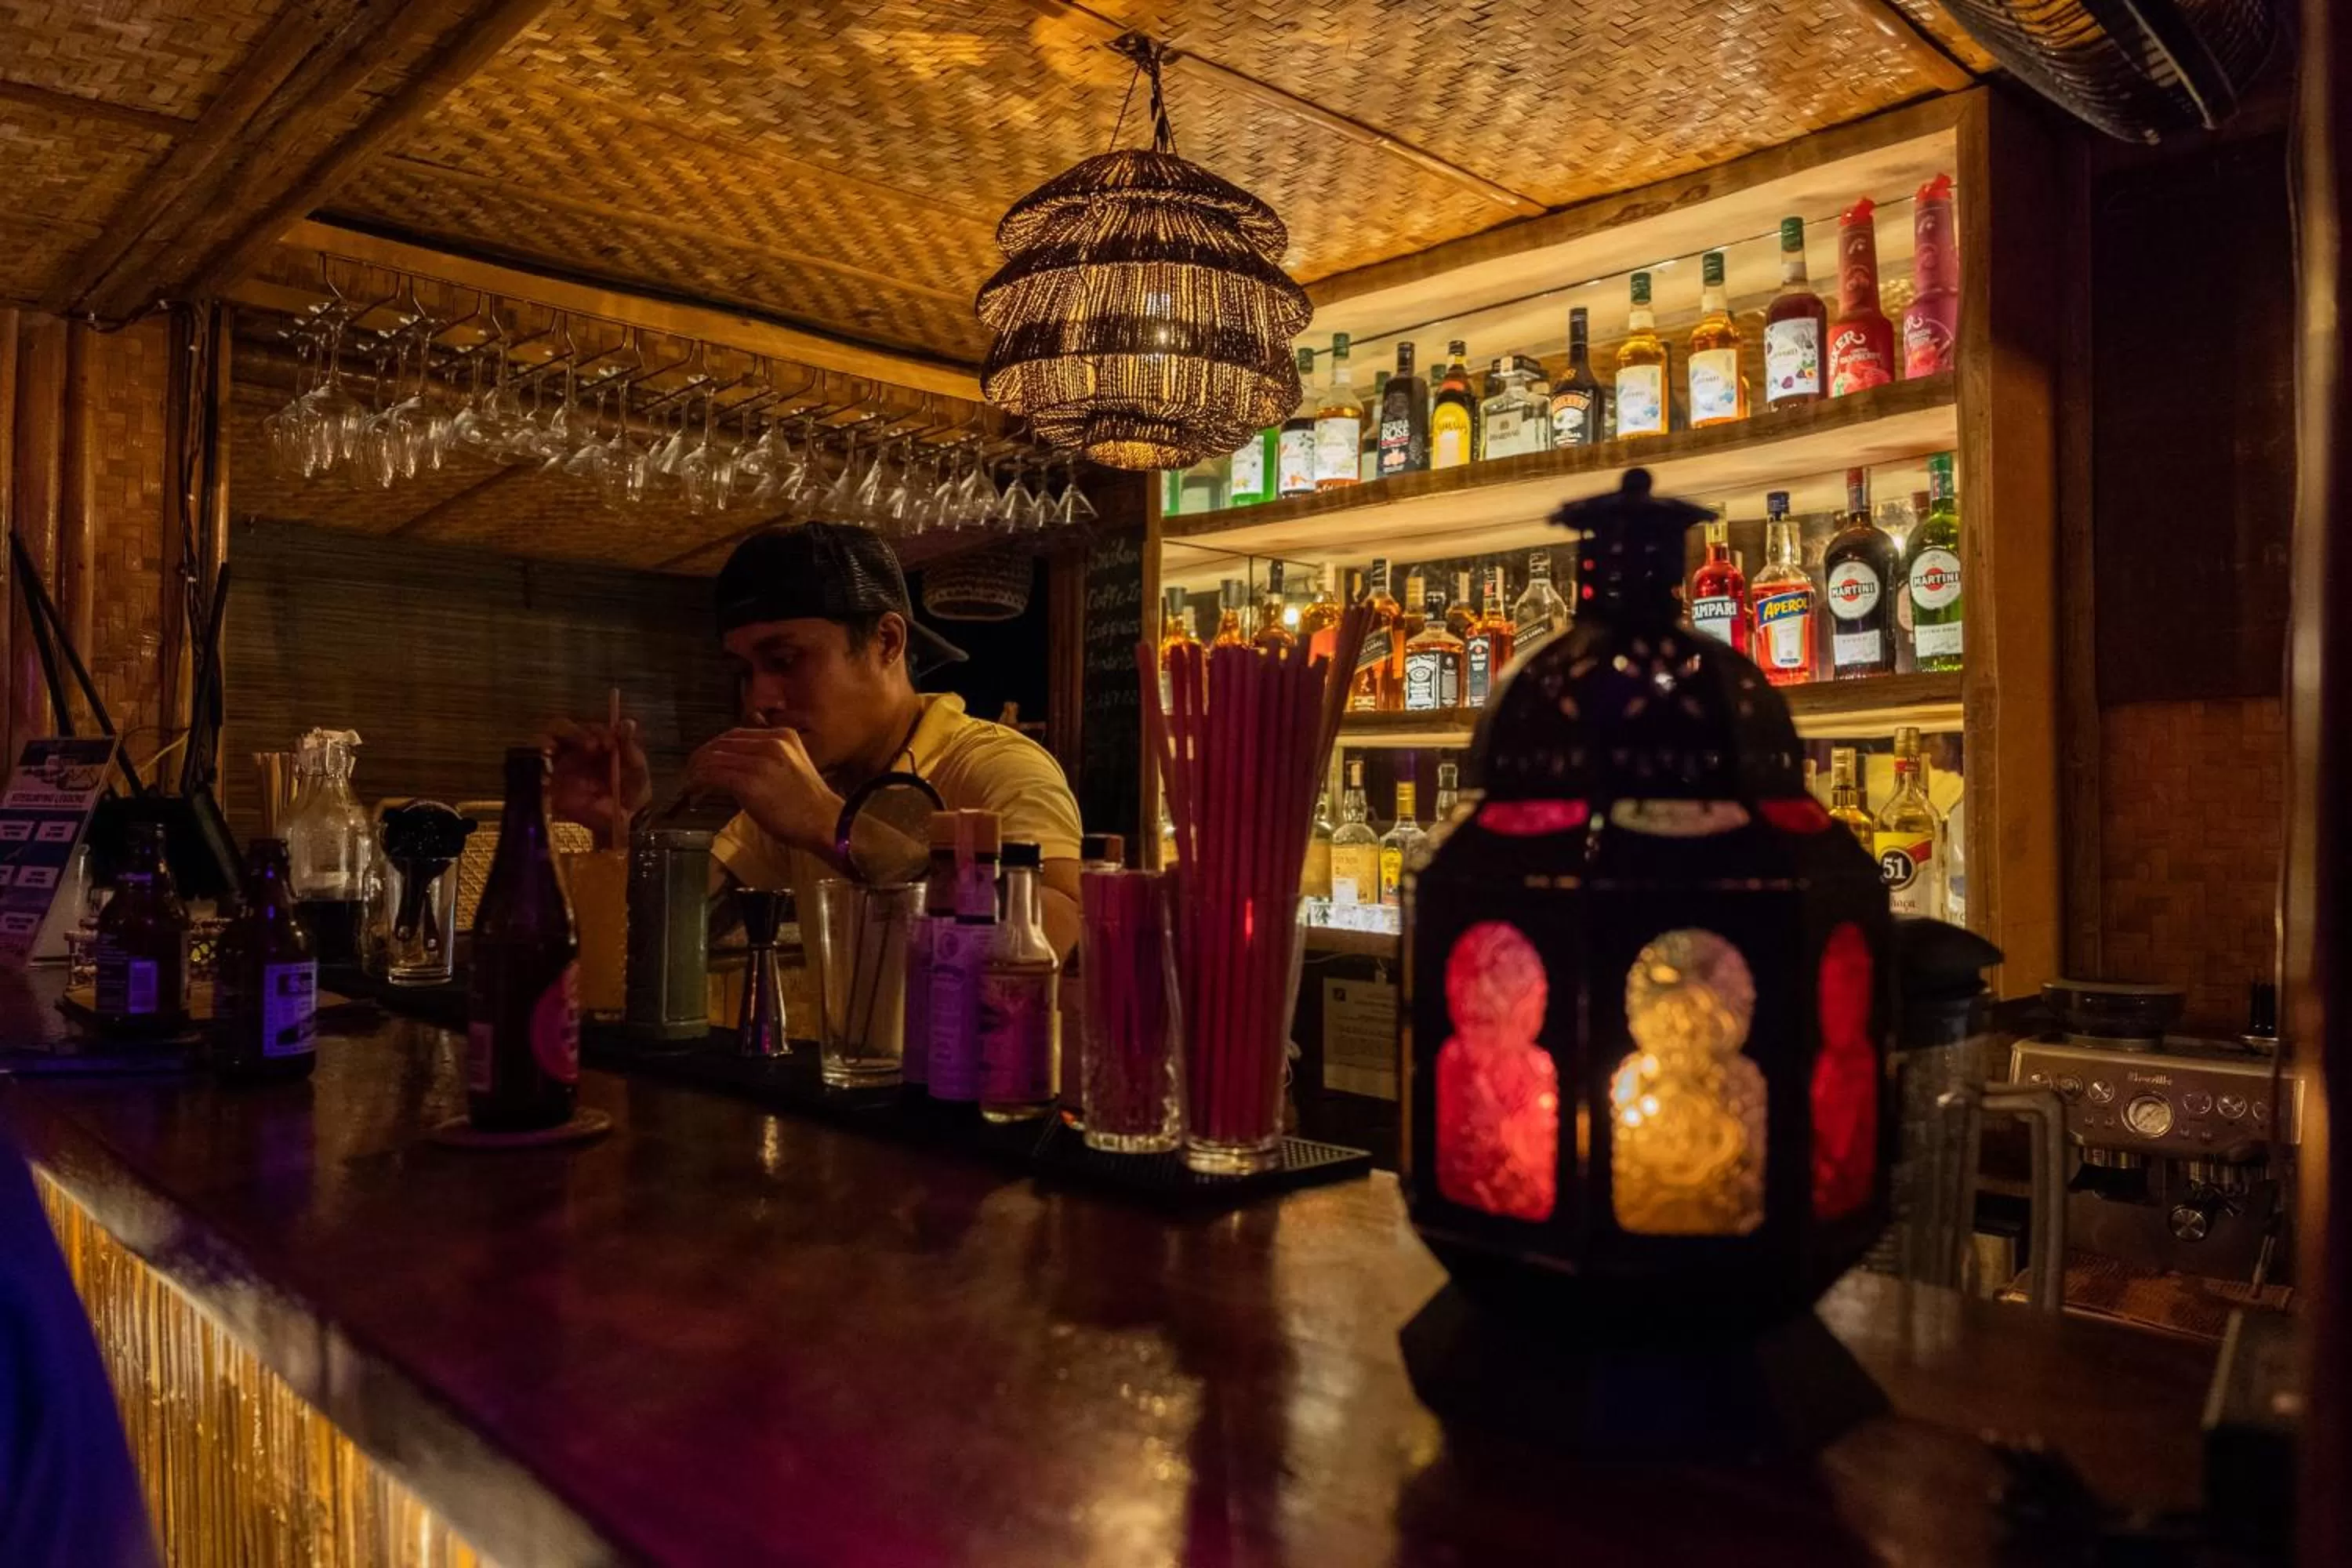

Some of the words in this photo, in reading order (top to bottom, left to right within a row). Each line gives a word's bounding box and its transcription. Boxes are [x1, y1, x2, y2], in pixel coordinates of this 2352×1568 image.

[1381, 428, 1410, 441] ROSE
[1912, 571, 1960, 587] MARTINI
[1831, 582, 1876, 598] MARTINI
[1882, 857, 1907, 879] 51
